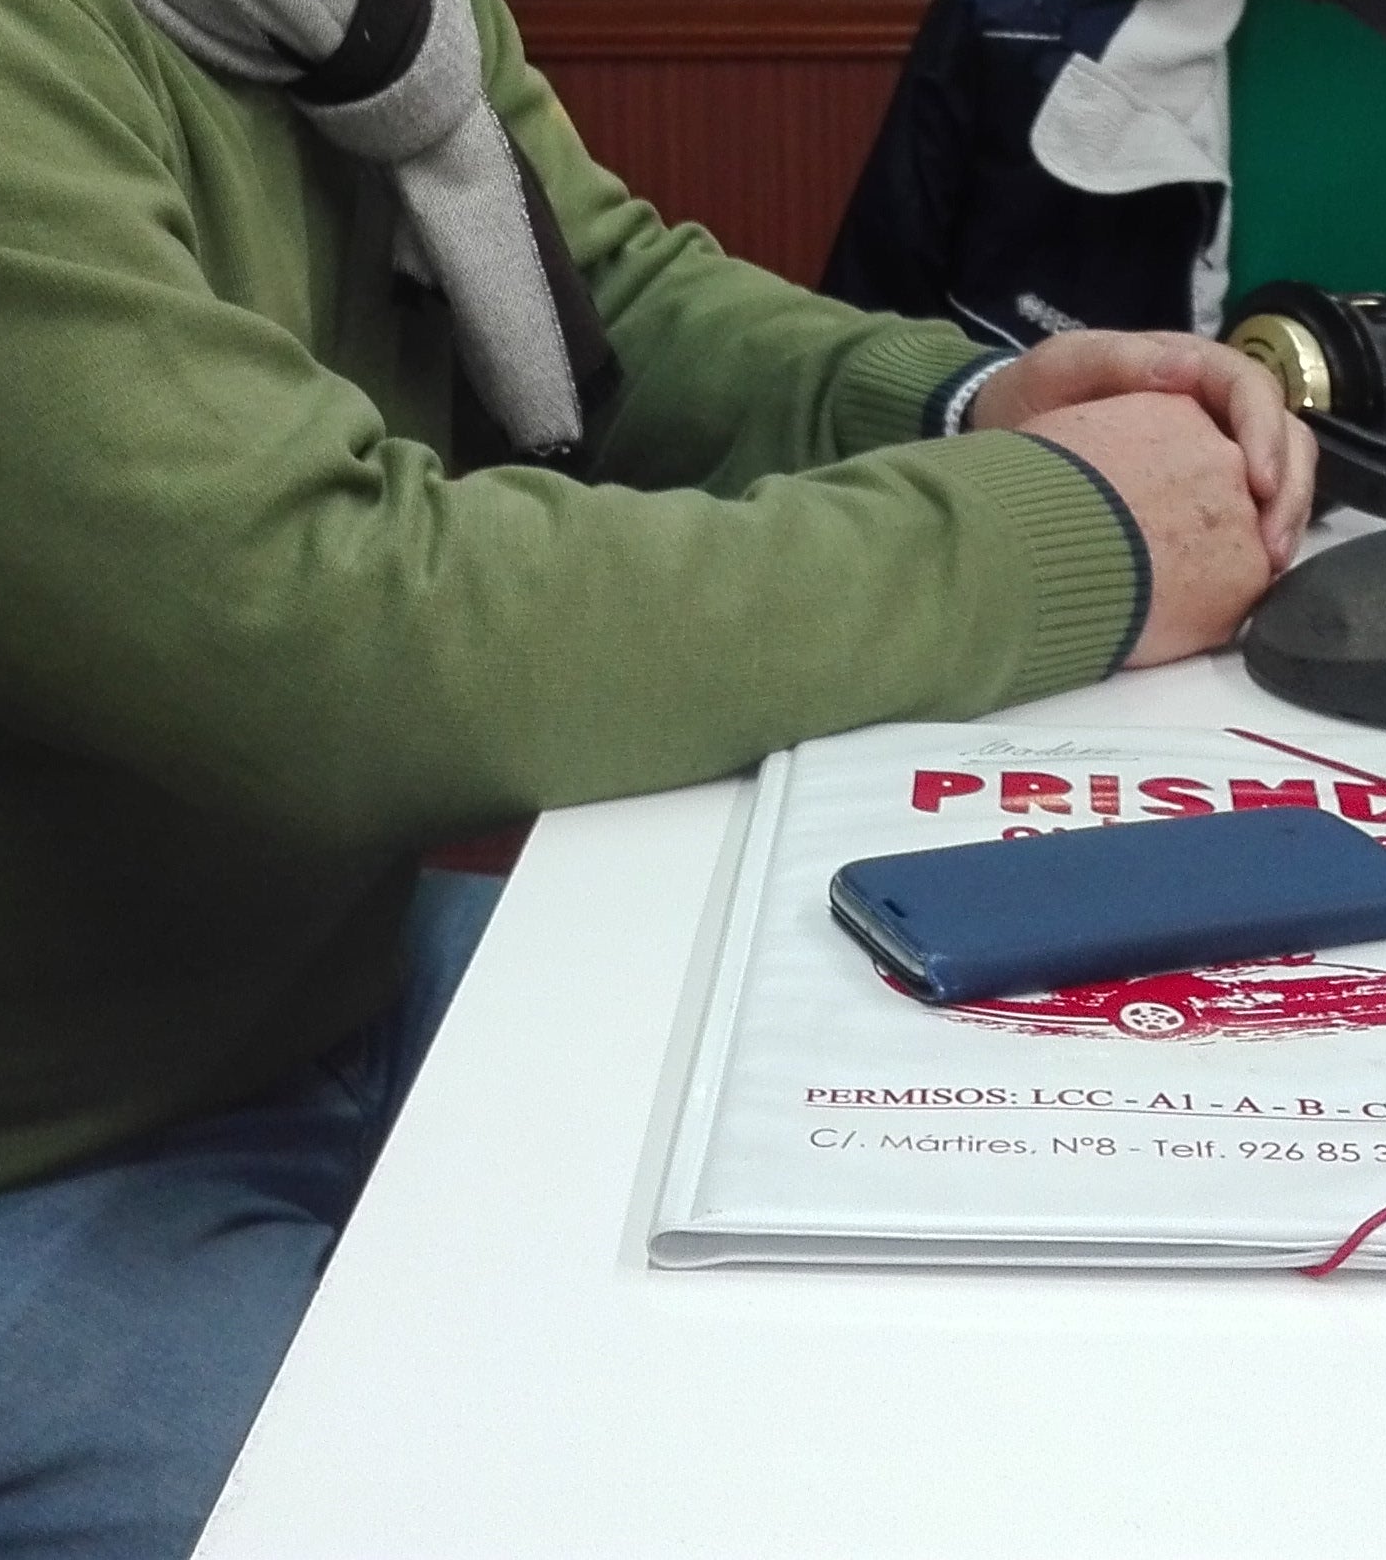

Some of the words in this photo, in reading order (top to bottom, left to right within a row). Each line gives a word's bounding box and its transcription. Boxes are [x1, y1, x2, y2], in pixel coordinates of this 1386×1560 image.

[805, 1087, 1019, 1106] PERMISOS:
[1030, 1088, 1114, 1108] LCC
[1146, 1091, 1195, 1111] A1
[1232, 1095, 1265, 1114] A
[1294, 1098, 1326, 1116] B
[809, 1127, 865, 1149] C/.
[1153, 1139, 1225, 1159] Telf.
[1238, 1140, 1305, 1162] 926
[1316, 1142, 1361, 1164] 85
